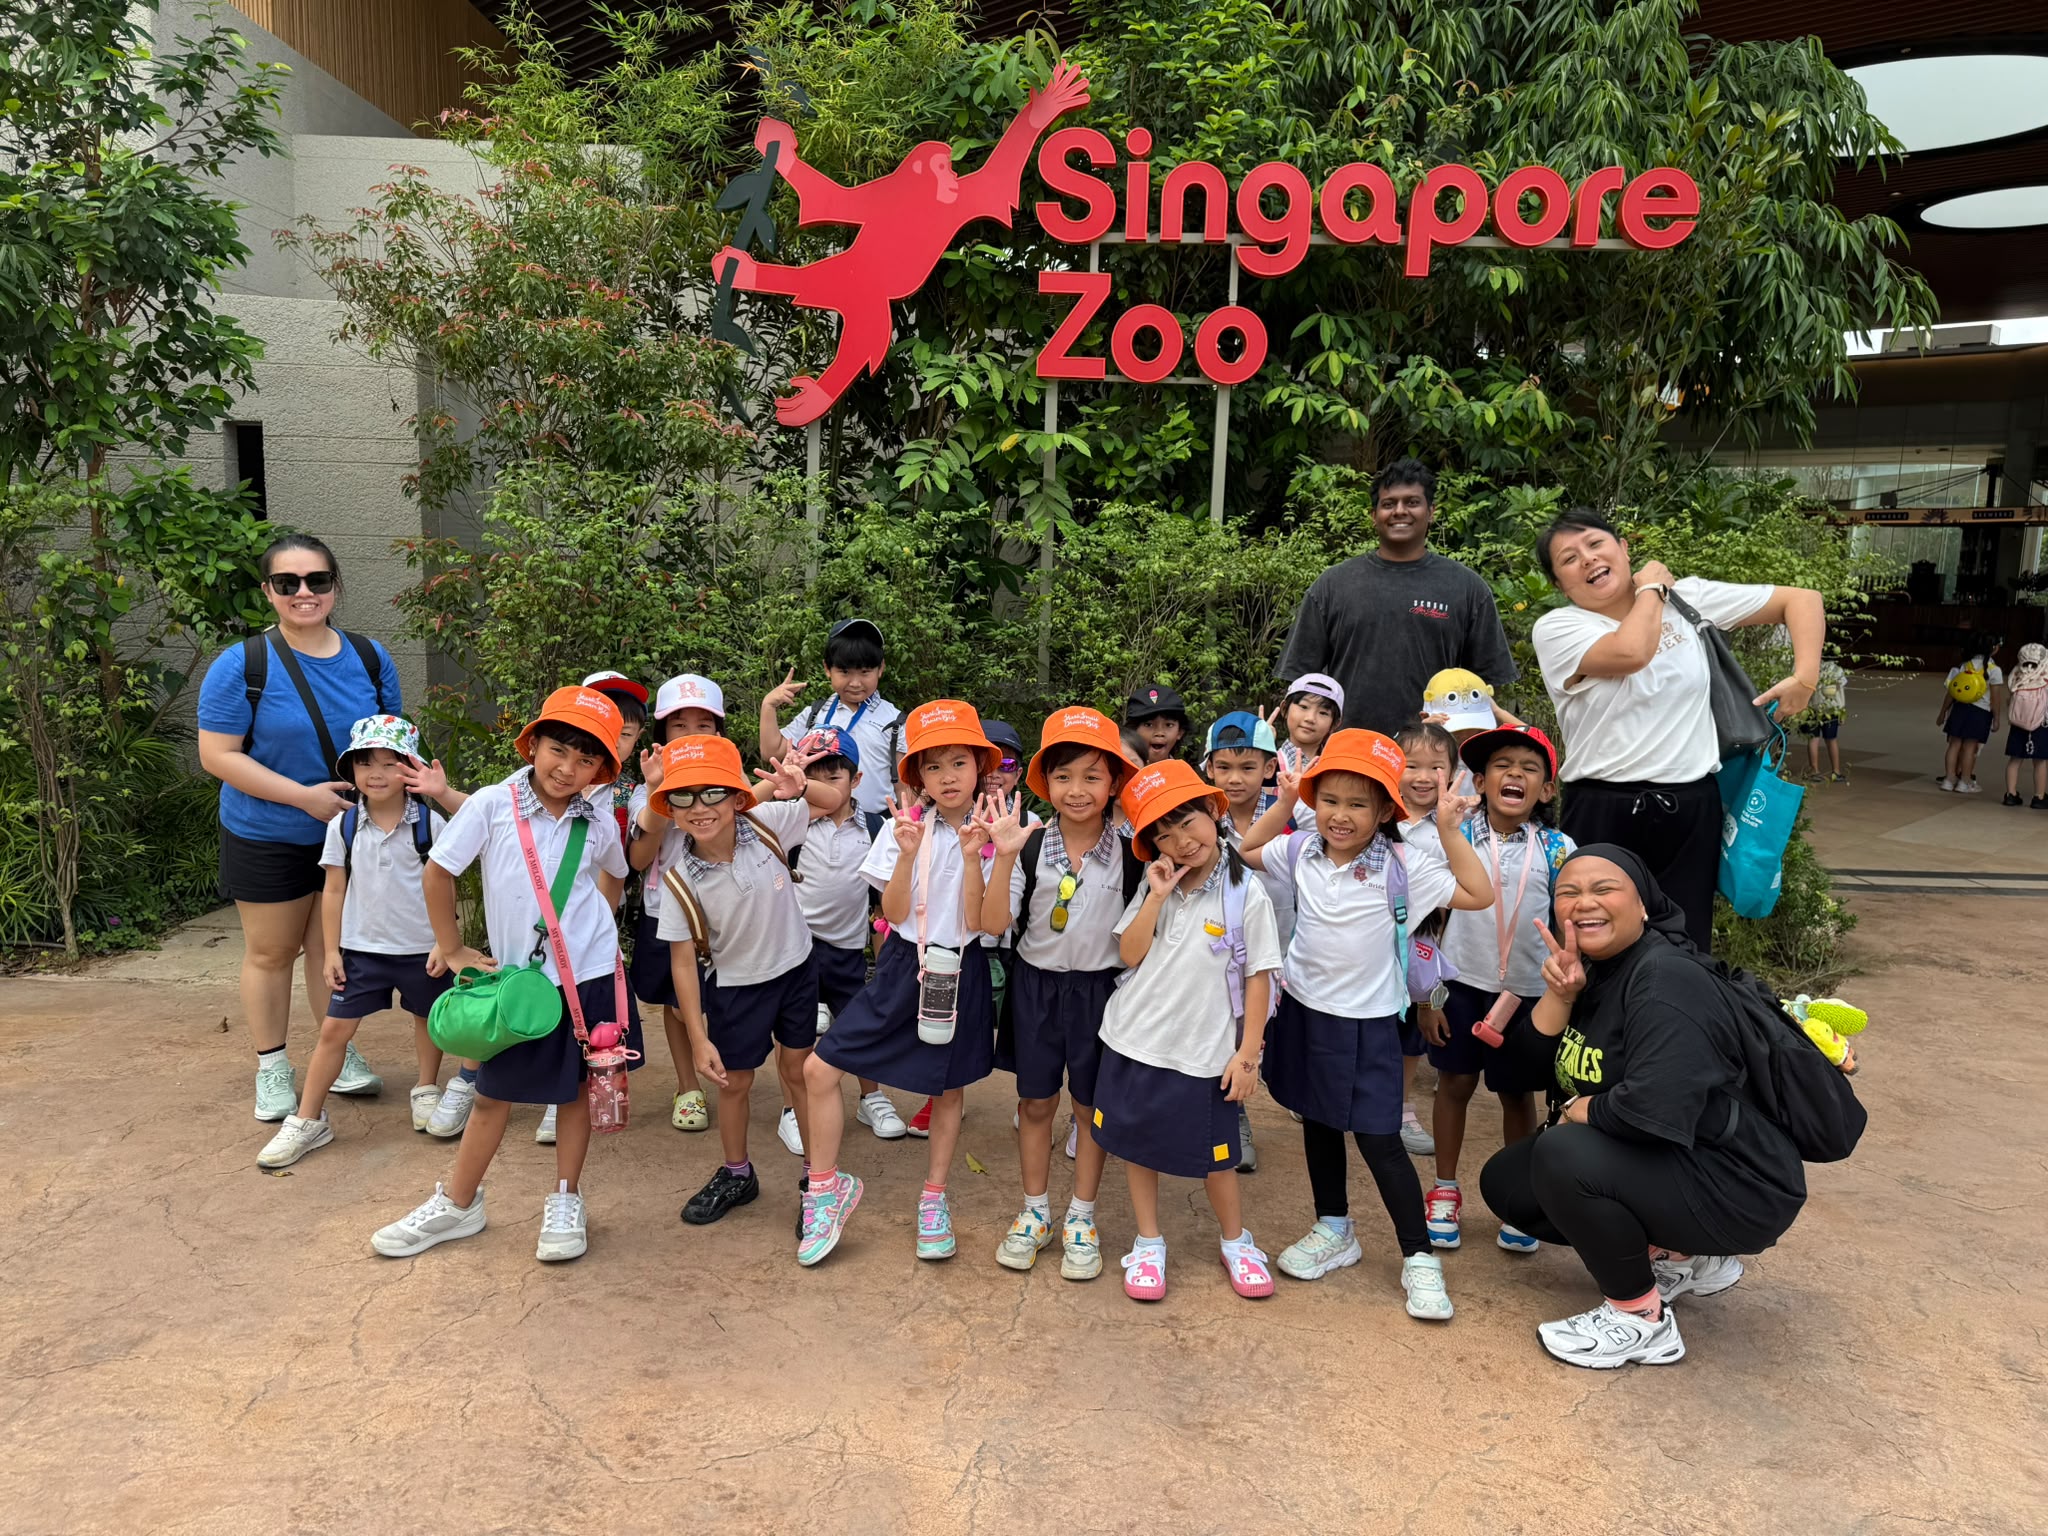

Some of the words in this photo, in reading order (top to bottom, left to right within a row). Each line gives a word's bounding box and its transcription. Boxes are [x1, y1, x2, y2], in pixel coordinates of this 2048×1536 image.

[1035, 127, 1700, 279] Singapore
[1036, 271, 1268, 384] Zoo
[526, 847, 534, 860] MY
[528, 859, 545, 890] MELODY
[550, 927, 560, 939] MY
[554, 938, 569, 969] MELODY
